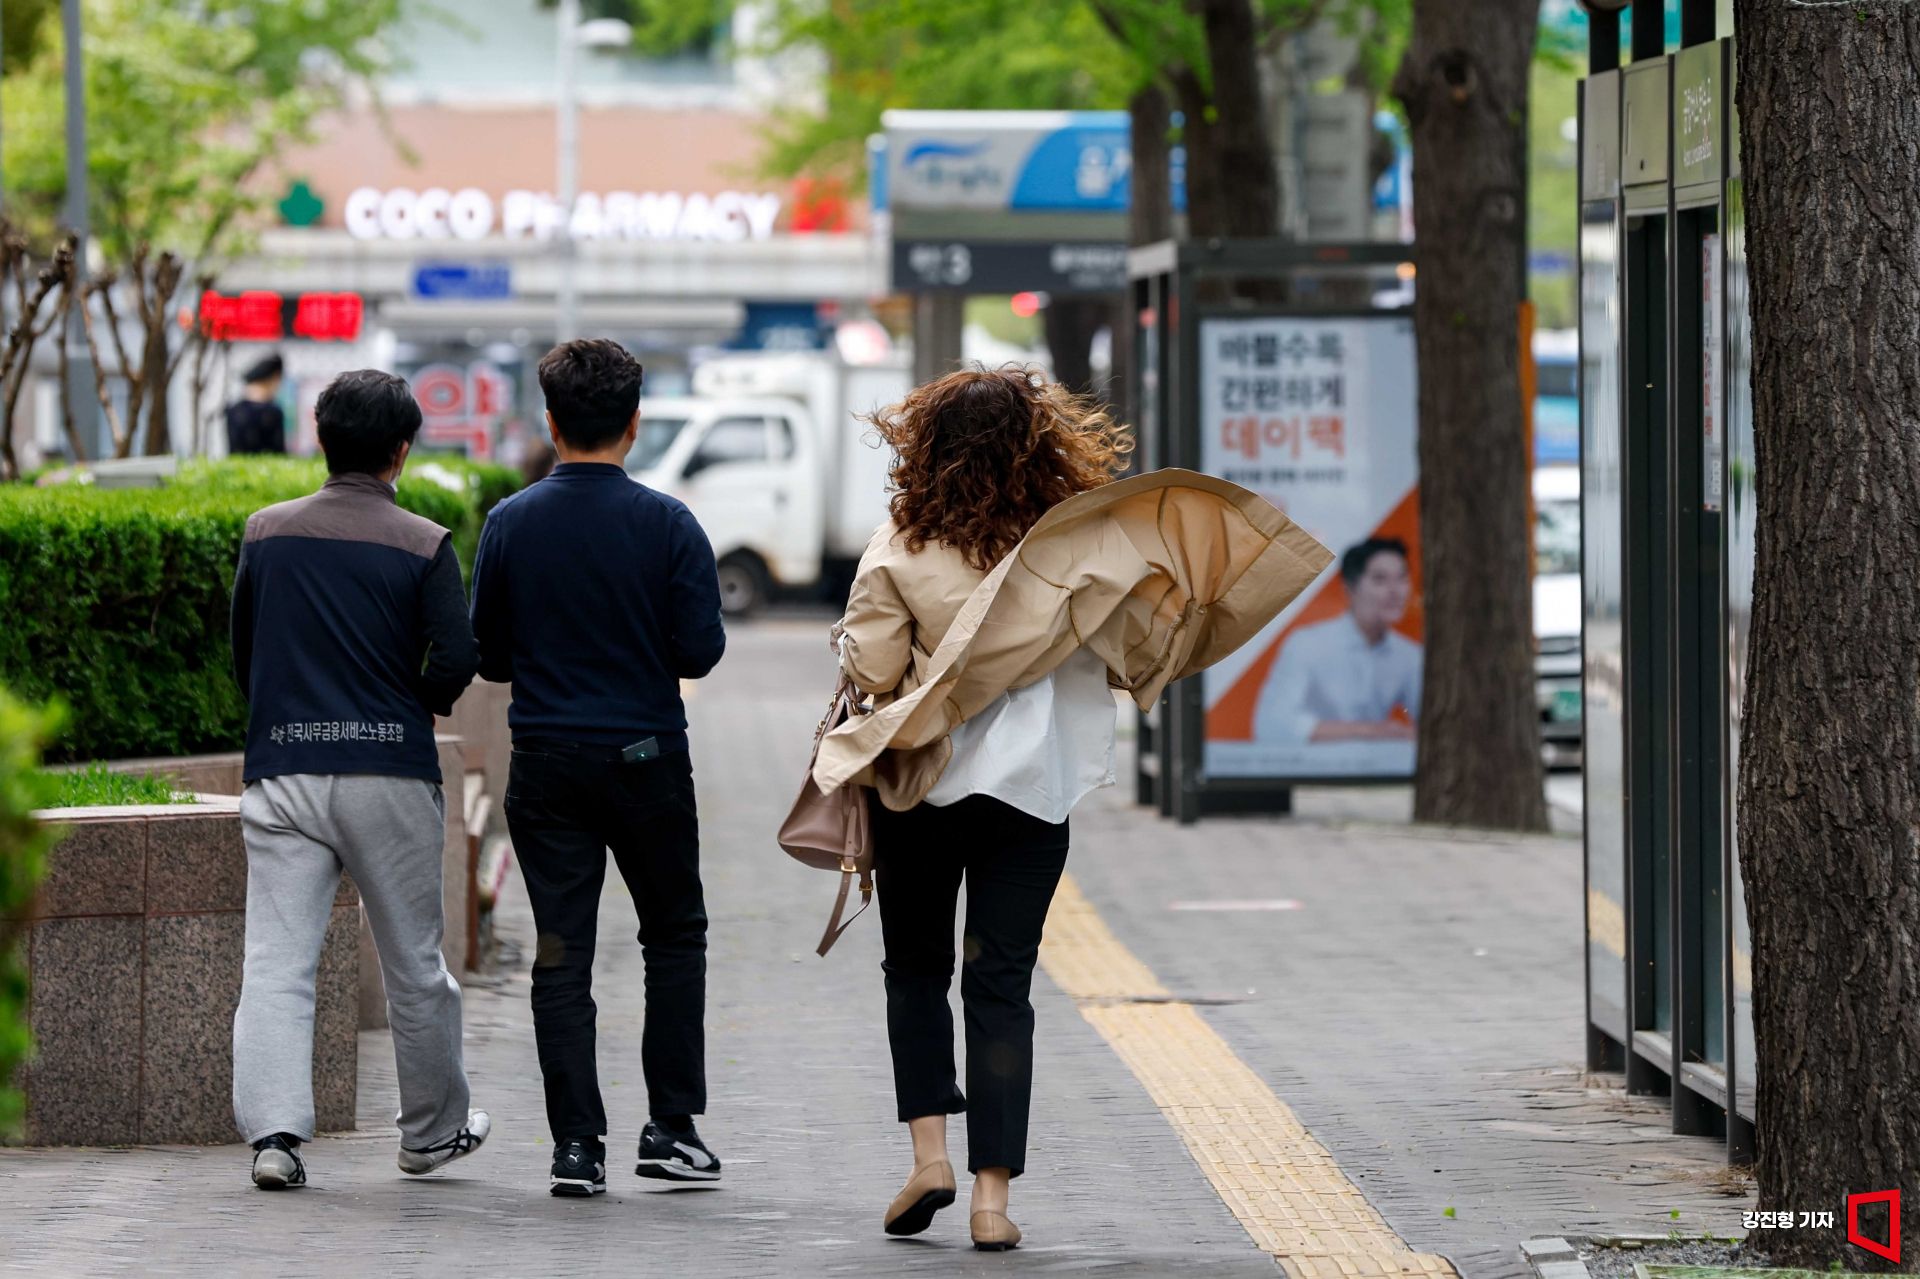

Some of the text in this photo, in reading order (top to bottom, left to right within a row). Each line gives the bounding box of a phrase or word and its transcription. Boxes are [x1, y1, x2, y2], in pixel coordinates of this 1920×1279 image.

[345, 187, 493, 240] COCO
[1219, 333, 1344, 367] 바쁠수록
[1220, 374, 1344, 412] 간편하게
[415, 368, 508, 459] 약
[287, 721, 404, 742] 전국사무금융서비스노동조합
